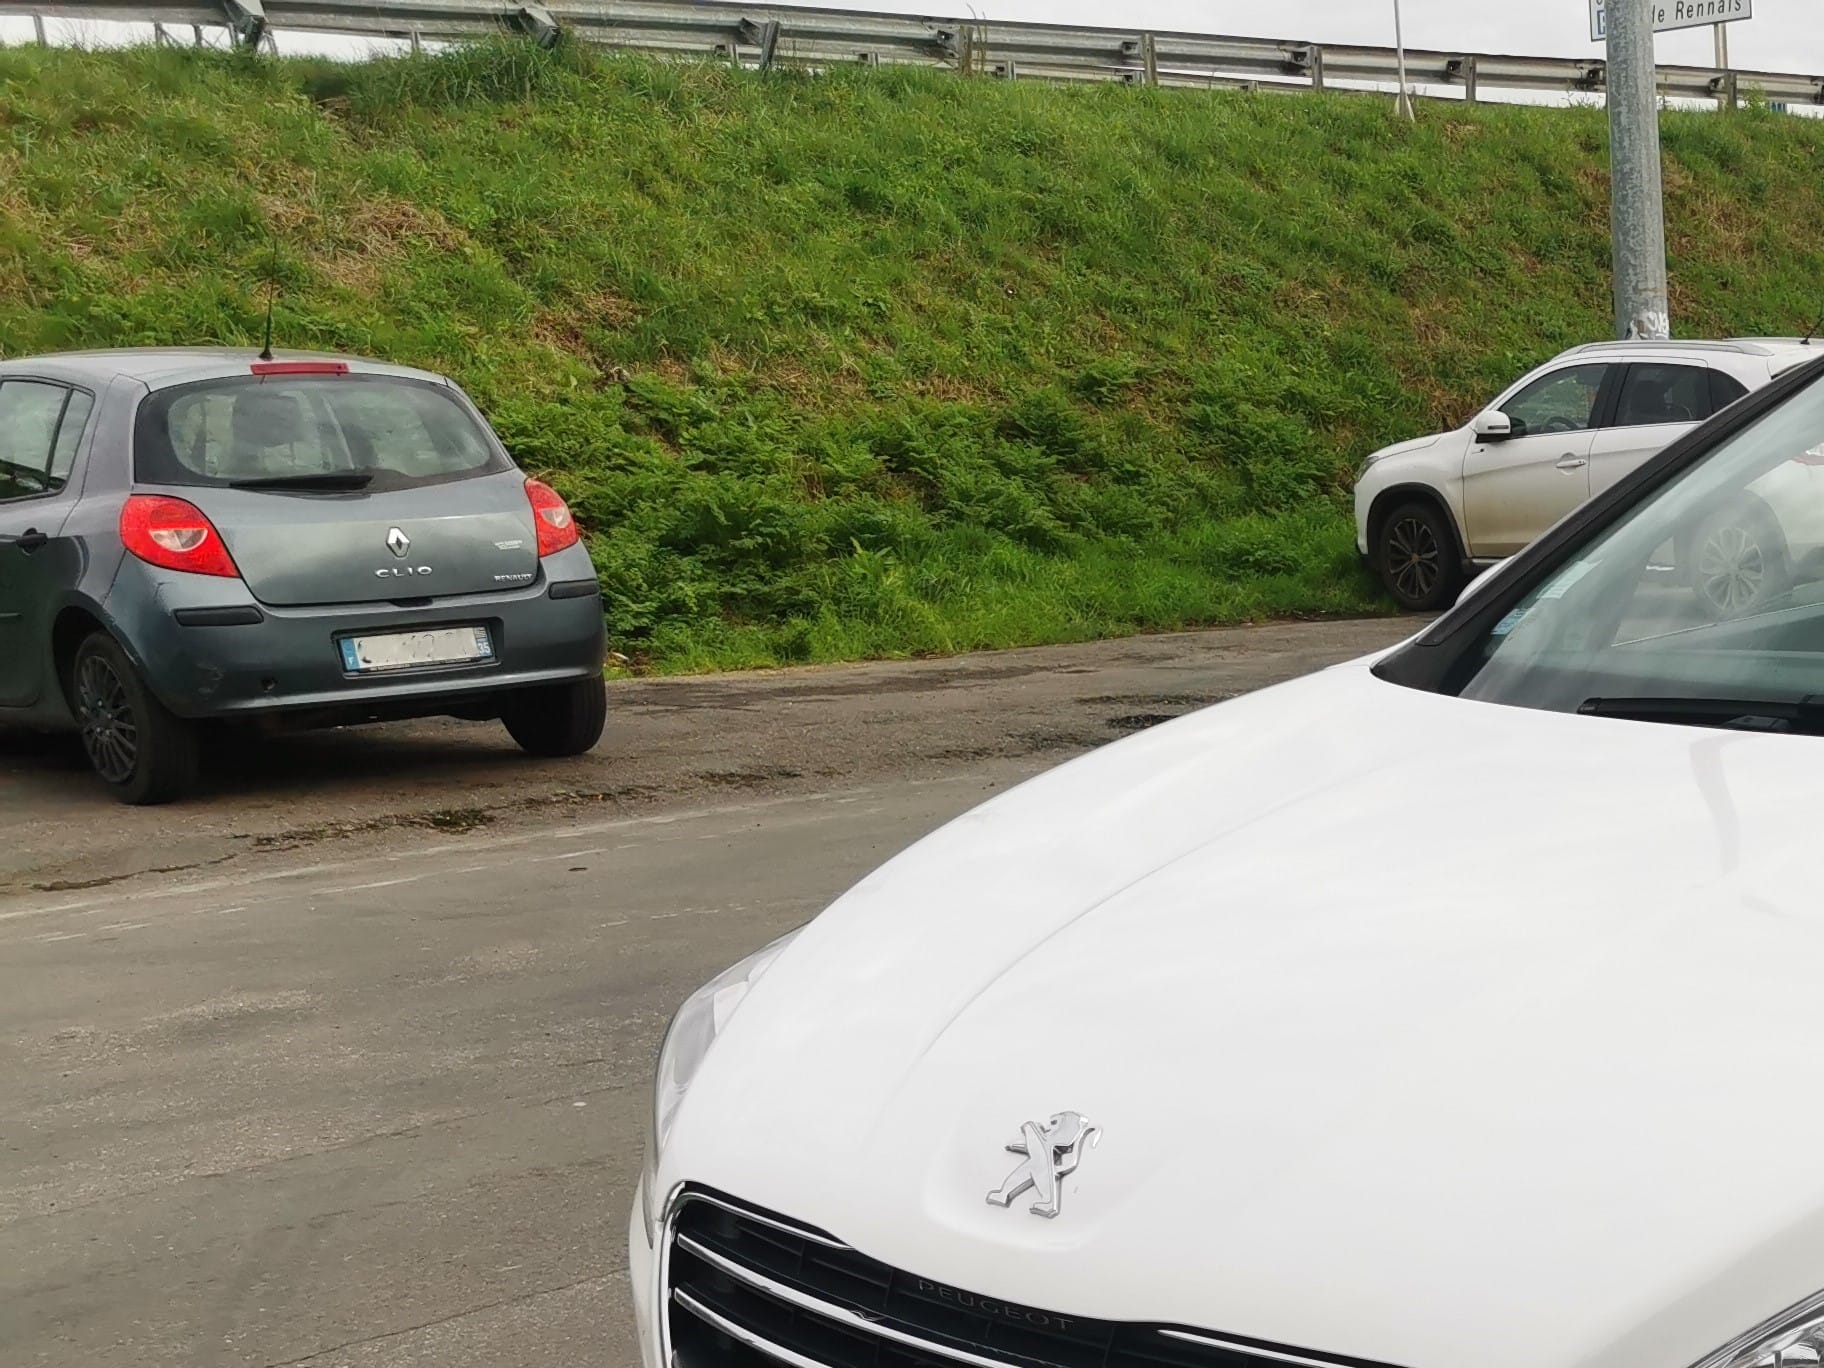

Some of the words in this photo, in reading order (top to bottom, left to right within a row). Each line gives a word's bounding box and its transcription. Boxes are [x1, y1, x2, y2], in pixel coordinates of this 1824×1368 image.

[1676, 0, 1742, 21] Rennais
[375, 566, 433, 578] CLIO
[494, 573, 533, 582] RENAULT
[479, 642, 491, 655] 35
[919, 1279, 1074, 1330] PEUGEOT
